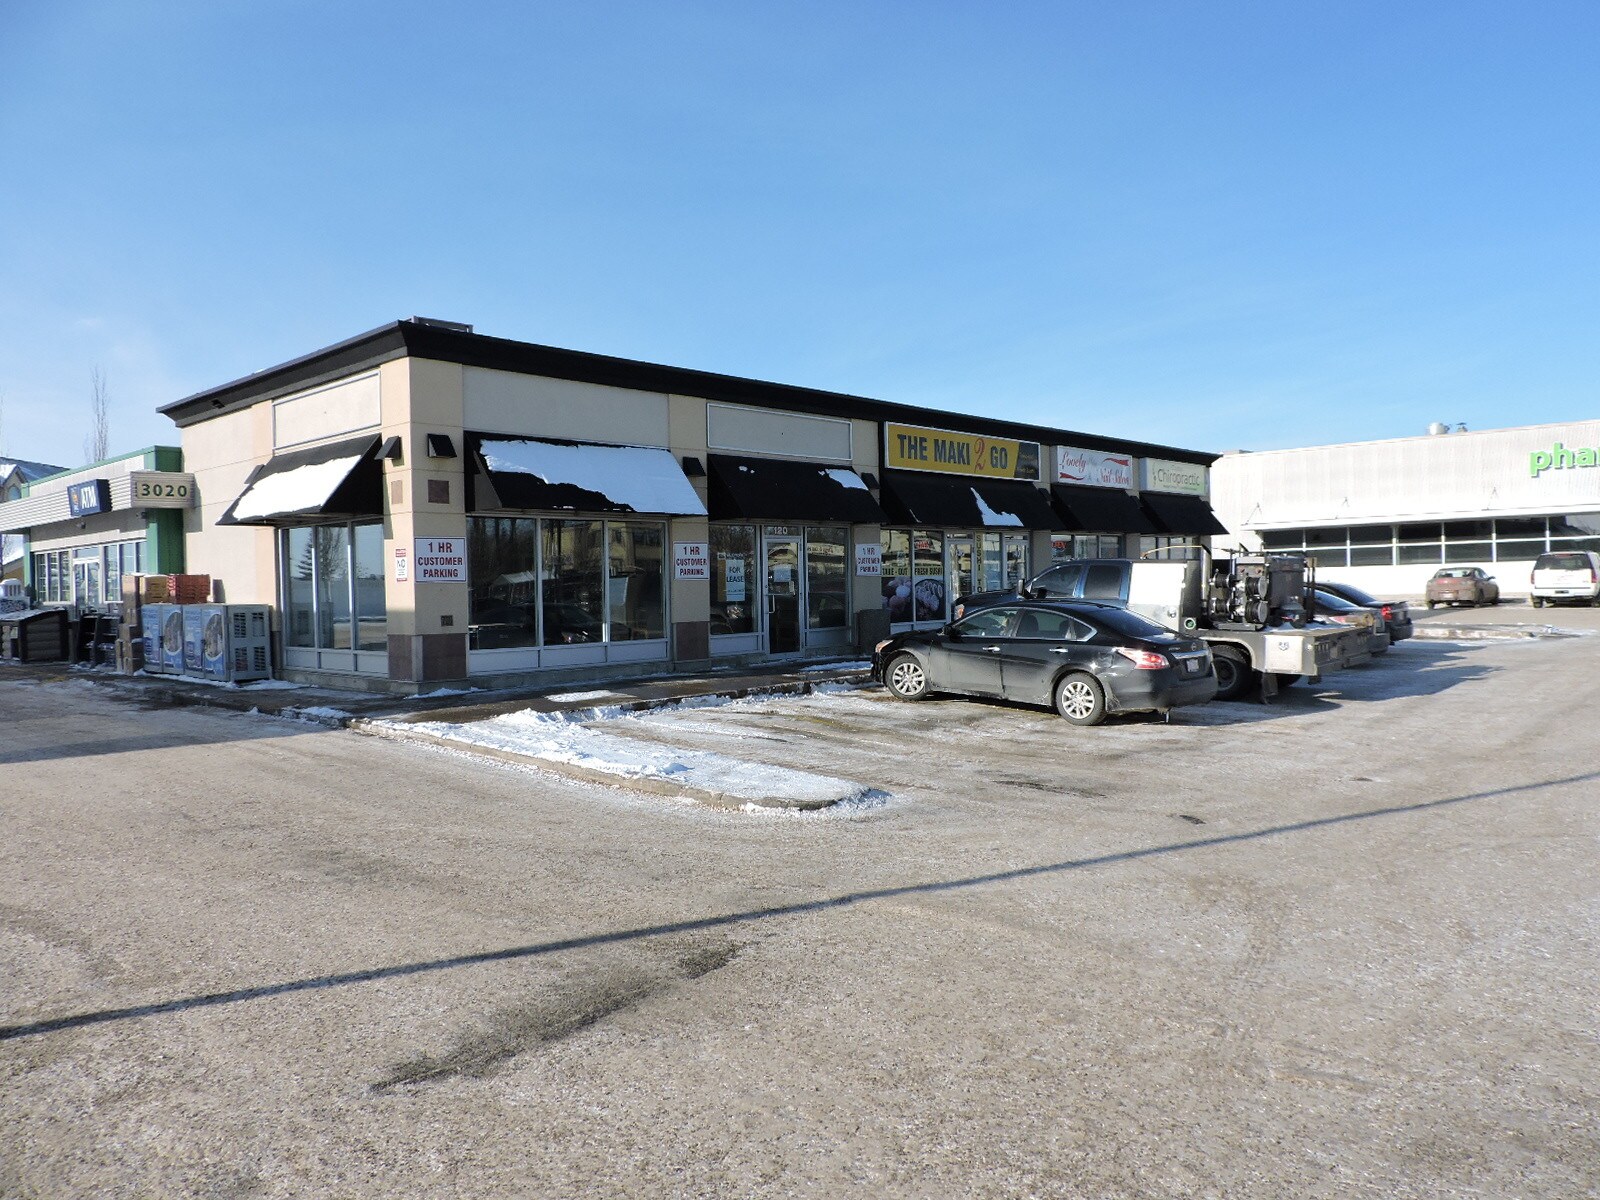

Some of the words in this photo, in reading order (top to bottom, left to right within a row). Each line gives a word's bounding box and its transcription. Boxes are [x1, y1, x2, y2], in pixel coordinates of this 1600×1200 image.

[896, 433, 928, 462] THE
[933, 438, 971, 466] MAKI
[973, 437, 986, 474] 2
[990, 446, 1008, 470] GO
[1157, 468, 1200, 487] Chiropractic
[141, 483, 188, 498] 3020
[81, 485, 98, 510] ATM
[773, 526, 788, 535] 120
[427, 541, 433, 553] 1
[438, 541, 453, 553] HR
[683, 546, 687, 555] 1
[690, 546, 700, 555] HR
[417, 556, 463, 566] CUSTOMER
[676, 558, 708, 566] CUSTOMER
[423, 568, 459, 578] PARKING
[679, 568, 704, 576] PARKING
[729, 566, 741, 574] FOR
[726, 575, 744, 583] LEASE
